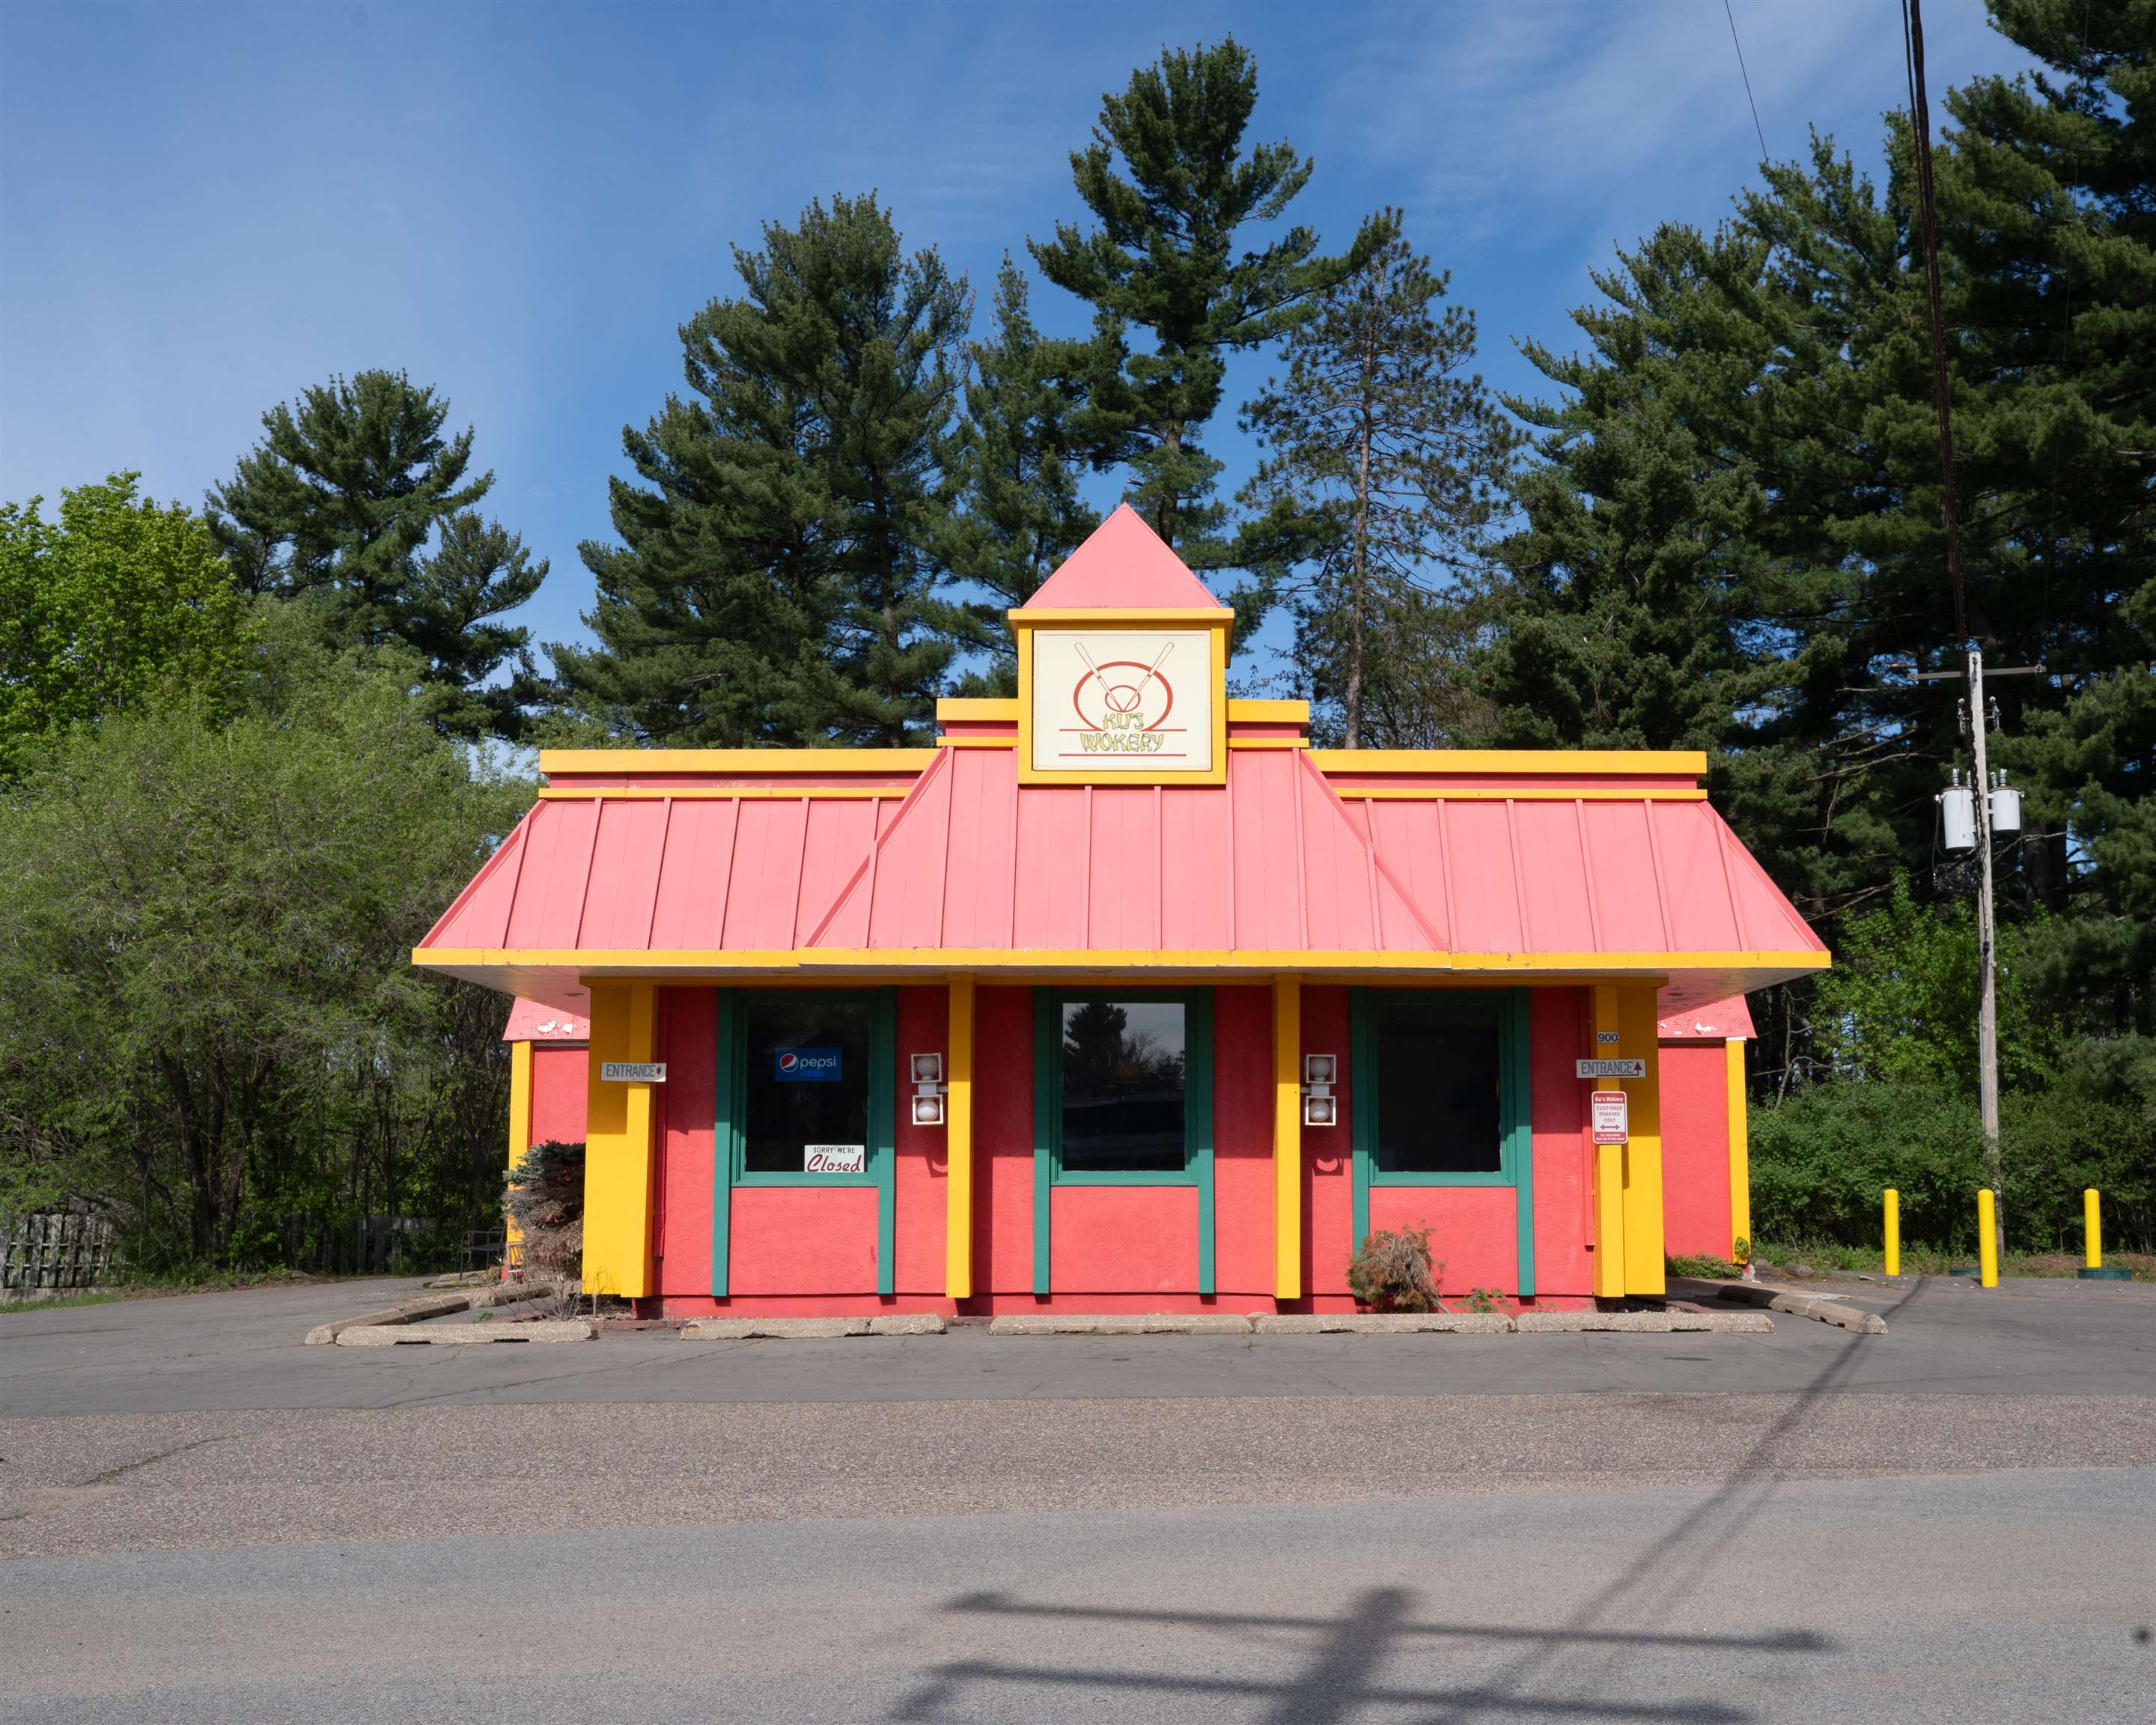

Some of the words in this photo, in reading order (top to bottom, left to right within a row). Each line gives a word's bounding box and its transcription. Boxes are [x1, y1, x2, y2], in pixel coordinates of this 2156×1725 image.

[1103, 712, 1144, 730] KU'S
[1080, 732, 1164, 752] WOKERY
[1598, 1033, 1618, 1042] 900
[800, 1056, 836, 1069] pepsi
[1581, 1061, 1633, 1074] ENTRANCE
[606, 1063, 655, 1077] ENTRANCE
[807, 1154, 862, 1172] Closed
